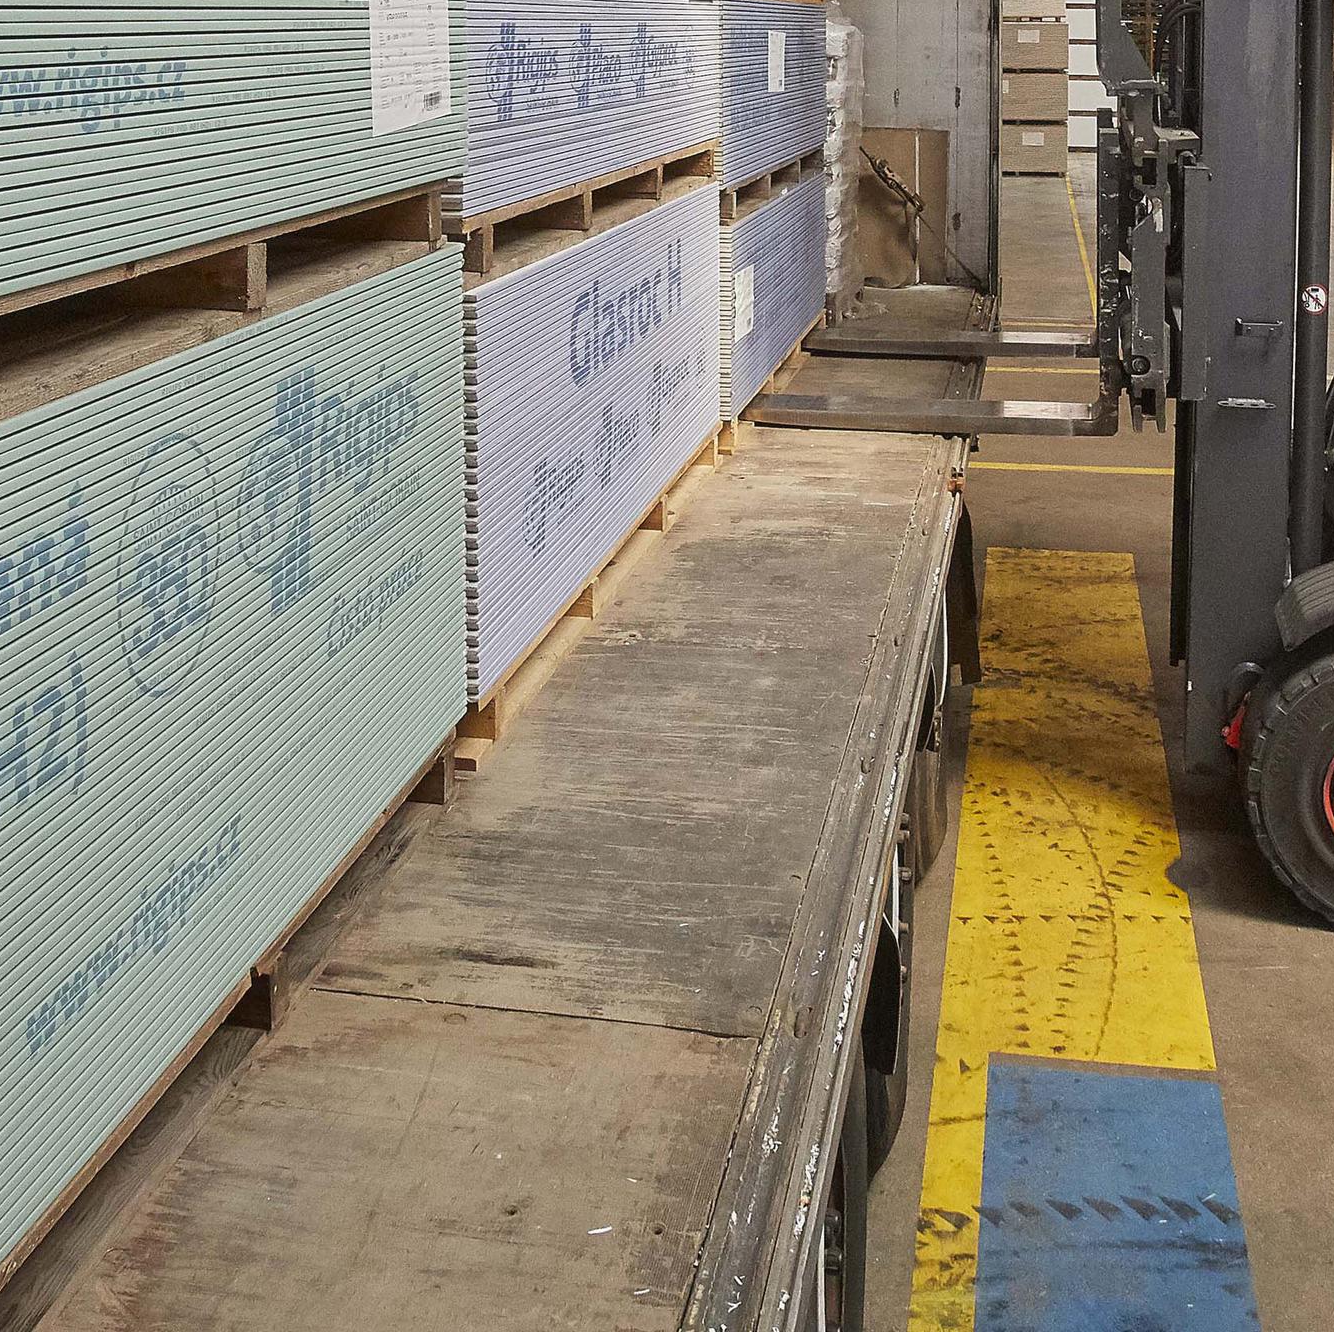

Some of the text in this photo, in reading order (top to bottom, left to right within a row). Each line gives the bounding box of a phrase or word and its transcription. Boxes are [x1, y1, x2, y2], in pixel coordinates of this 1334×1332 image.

[570, 279, 662, 388] Glasroc
[667, 237, 682, 316] H
[318, 362, 420, 494] Rigips
[26, 813, 242, 1059] www.rigips.cz
